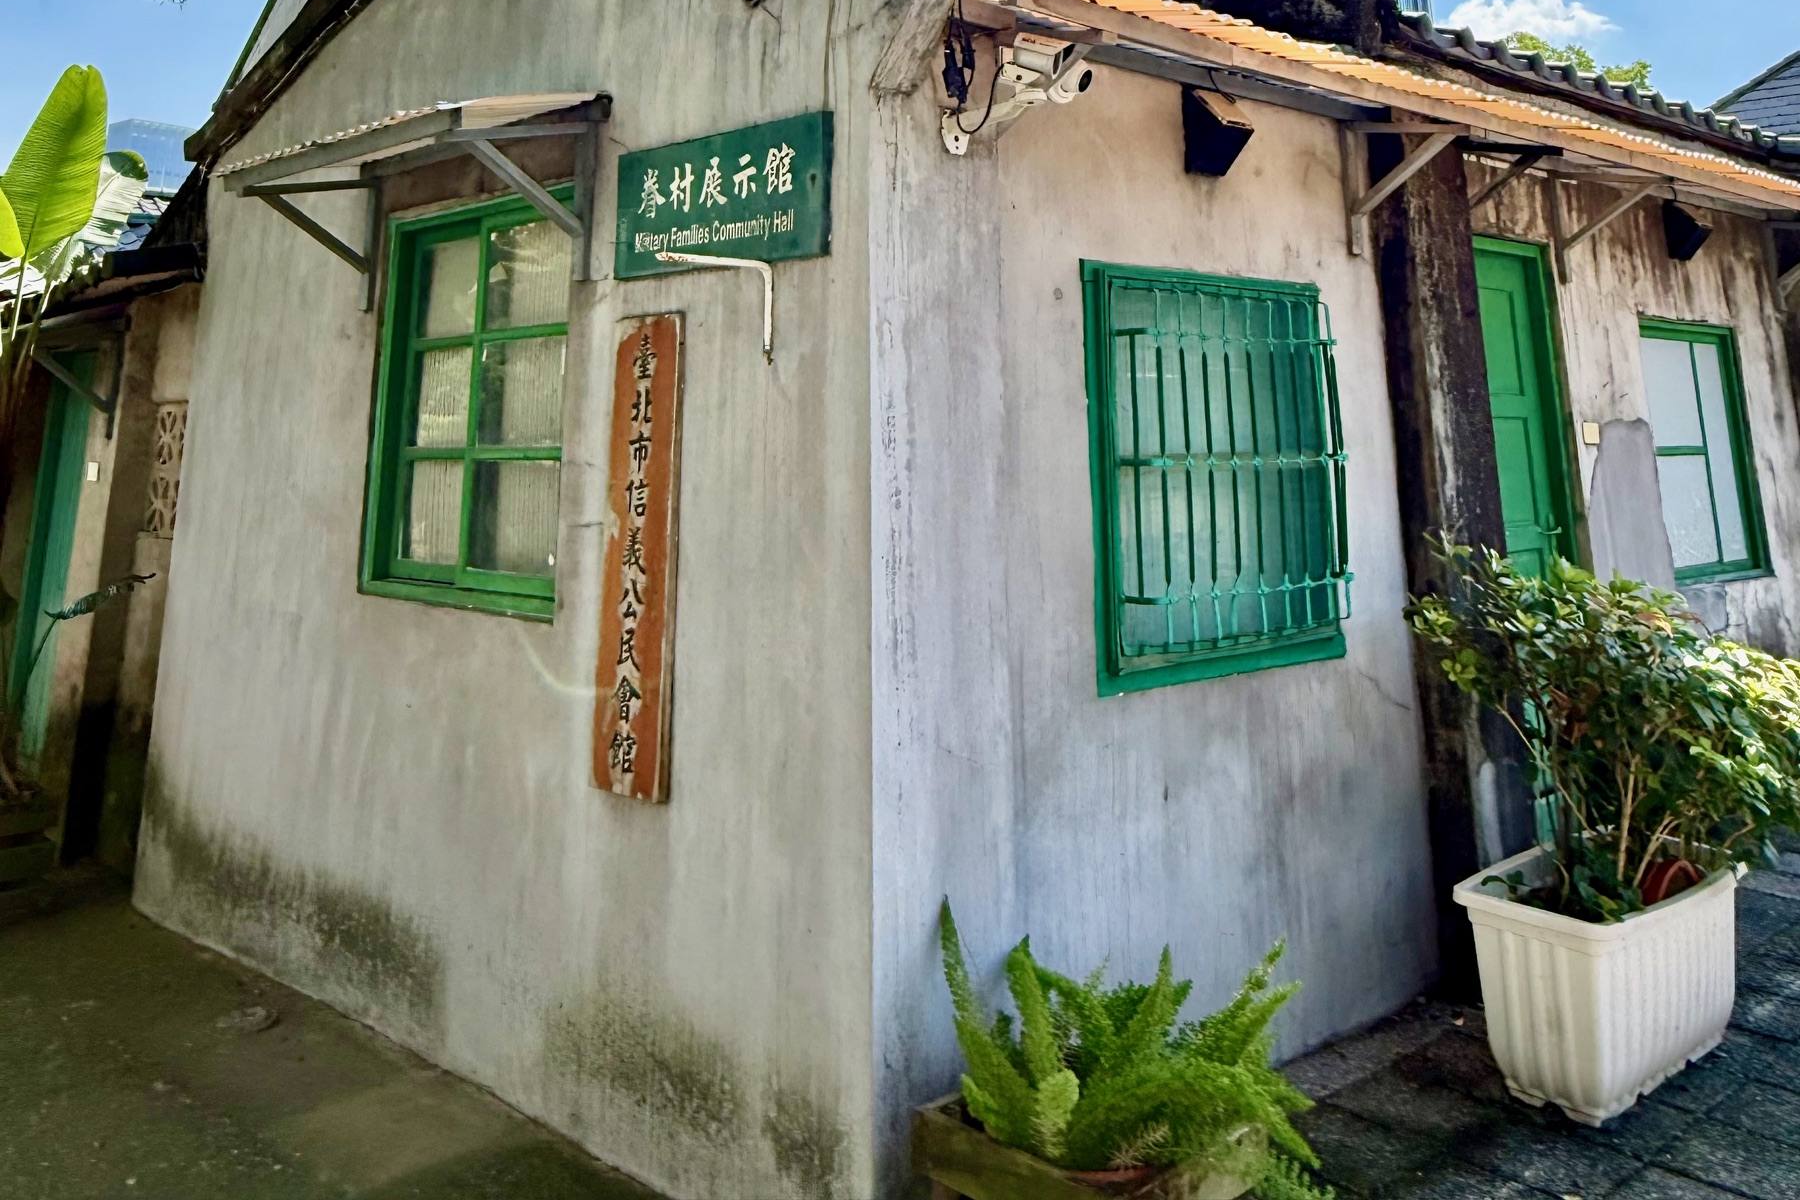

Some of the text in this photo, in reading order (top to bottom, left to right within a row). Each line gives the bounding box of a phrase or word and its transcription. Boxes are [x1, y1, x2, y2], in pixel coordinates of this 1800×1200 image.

[638, 142, 796, 219] 眷村展示館
[634, 209, 794, 253] Mtary Families Community Hall
[607, 333, 657, 773] 臺北市信義公民會館
